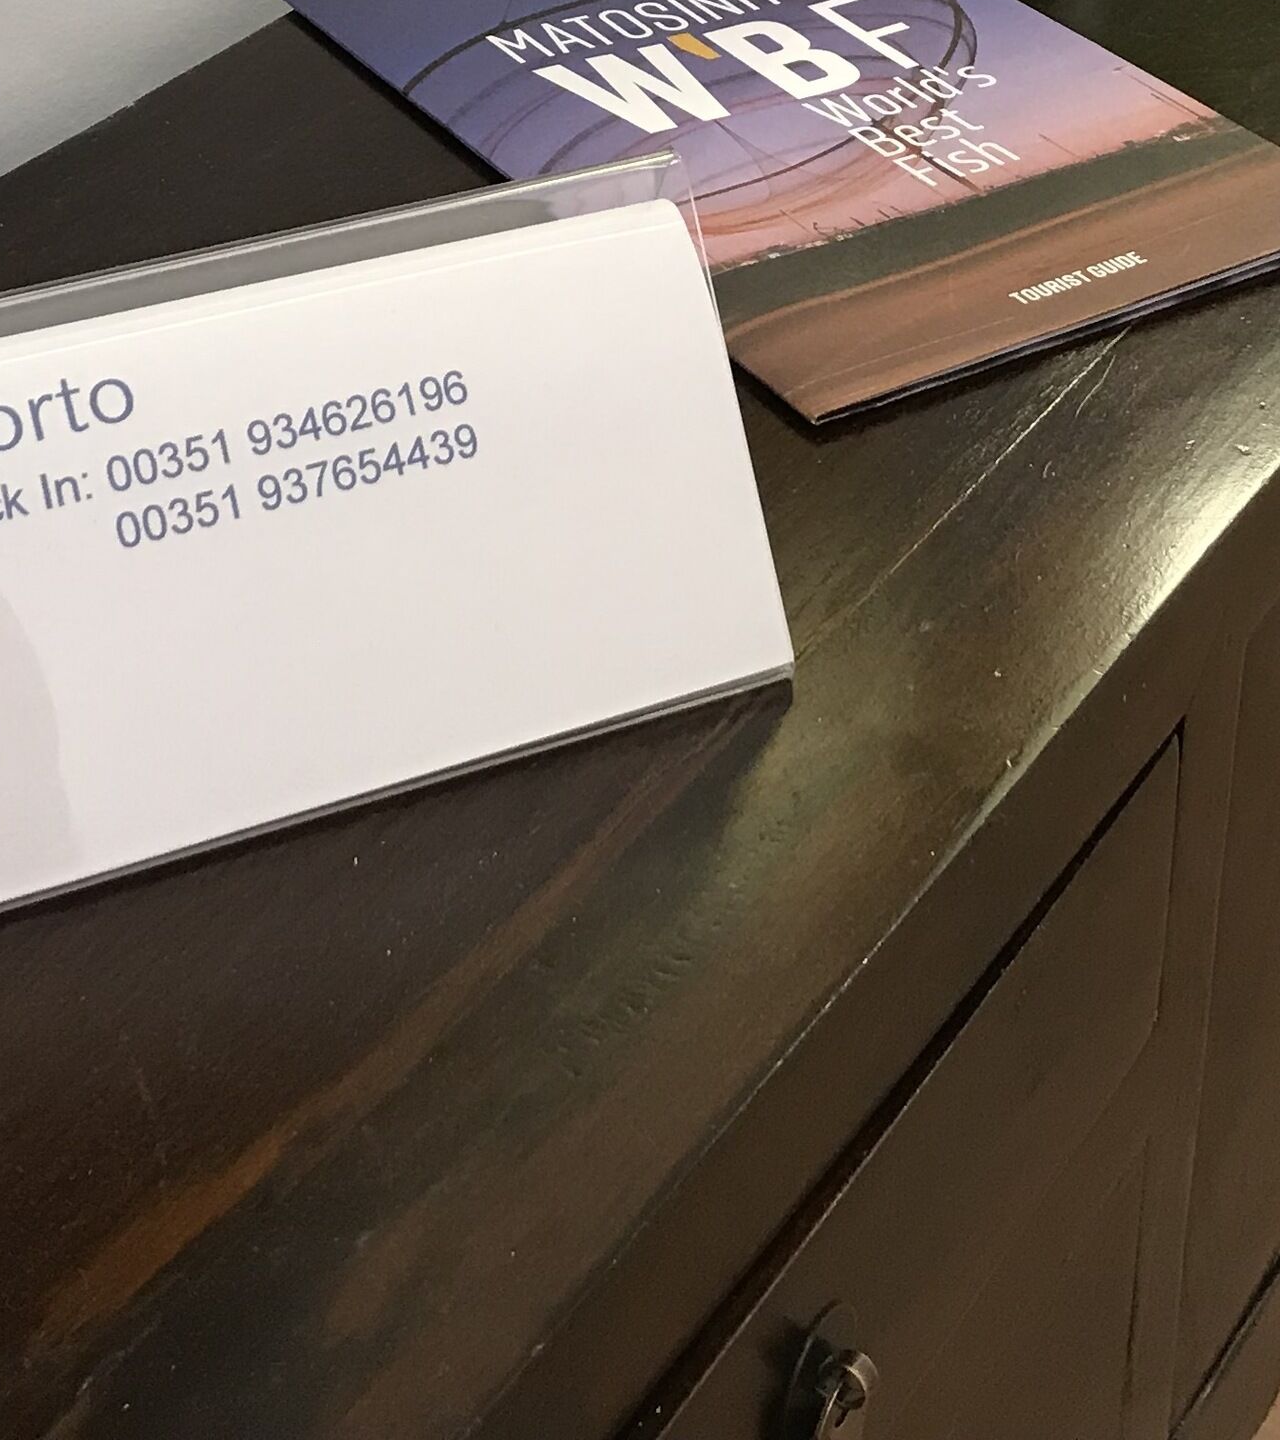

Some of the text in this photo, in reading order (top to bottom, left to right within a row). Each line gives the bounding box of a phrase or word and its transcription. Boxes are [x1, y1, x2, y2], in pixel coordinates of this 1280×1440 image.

[801, 65, 998, 128] World's
[847, 107, 985, 159] Best
[894, 138, 1021, 188] Fish
[1008, 250, 1149, 306] TOURIST GUIDE
[39, 468, 95, 511] In:
[105, 428, 232, 492] 00351
[246, 369, 470, 457] 934626196
[115, 422, 479, 549] 00351 937654439
